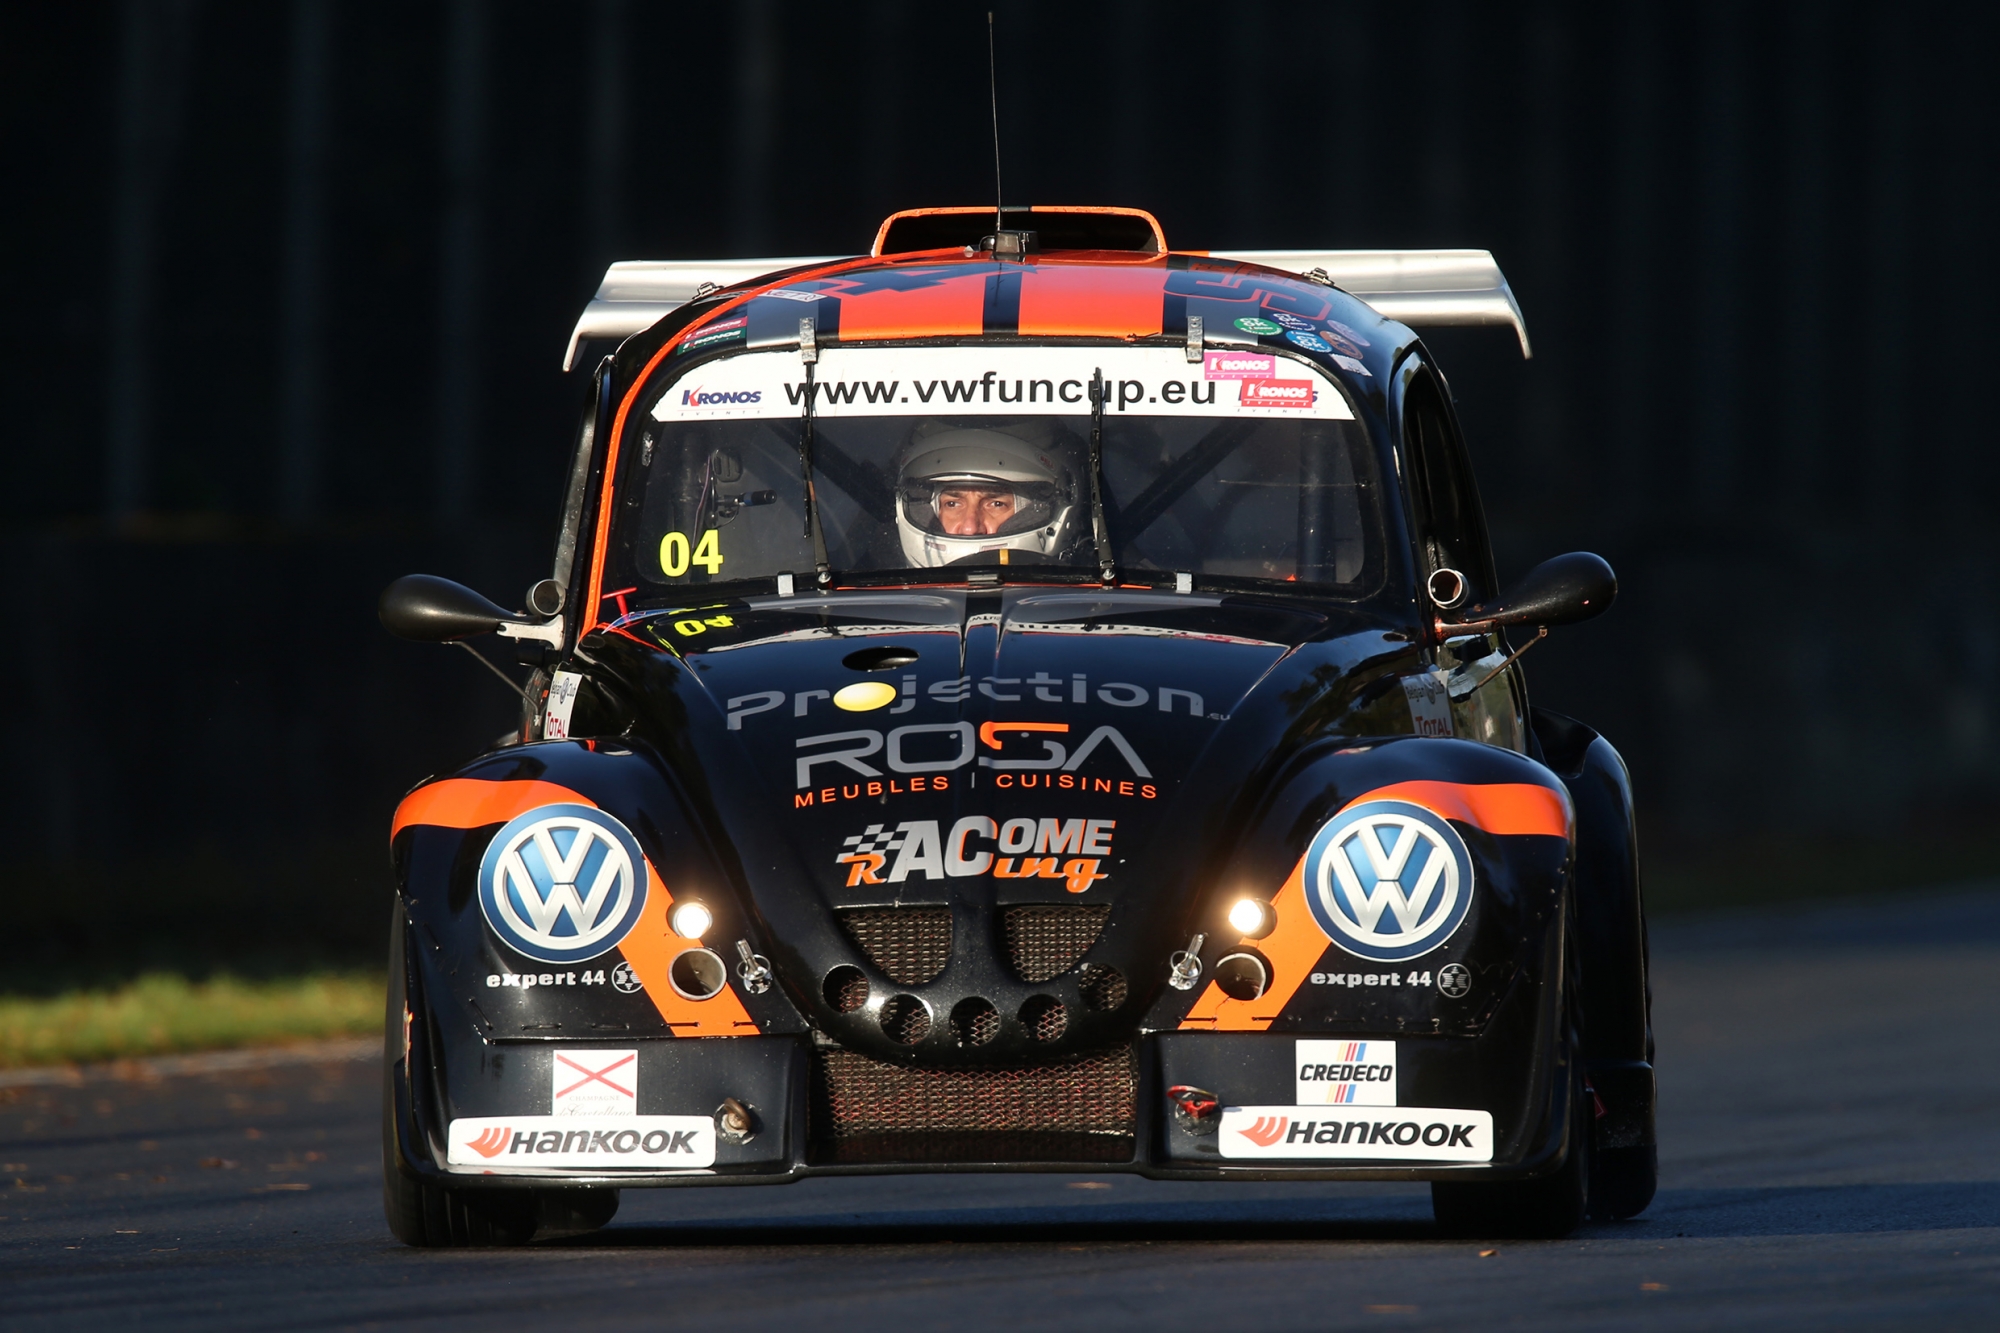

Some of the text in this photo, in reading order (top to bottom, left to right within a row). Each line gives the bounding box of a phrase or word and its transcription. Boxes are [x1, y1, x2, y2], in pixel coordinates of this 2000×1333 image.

[1210, 353, 1271, 372] KRONOS
[682, 384, 762, 406] KRONOS
[784, 372, 1216, 411] www.vwfuncup.eu
[1247, 380, 1308, 399] KRONOS
[659, 529, 724, 578] 04
[547, 711, 566, 738] TOTAL
[1415, 715, 1451, 736] TOTAL
[795, 721, 1154, 790] ROSA
[794, 773, 1158, 810] MEUBLES CUISINES
[486, 970, 606, 990] expert 44
[1310, 971, 1432, 988] expert 44
[1300, 1064, 1393, 1082] CREDECO
